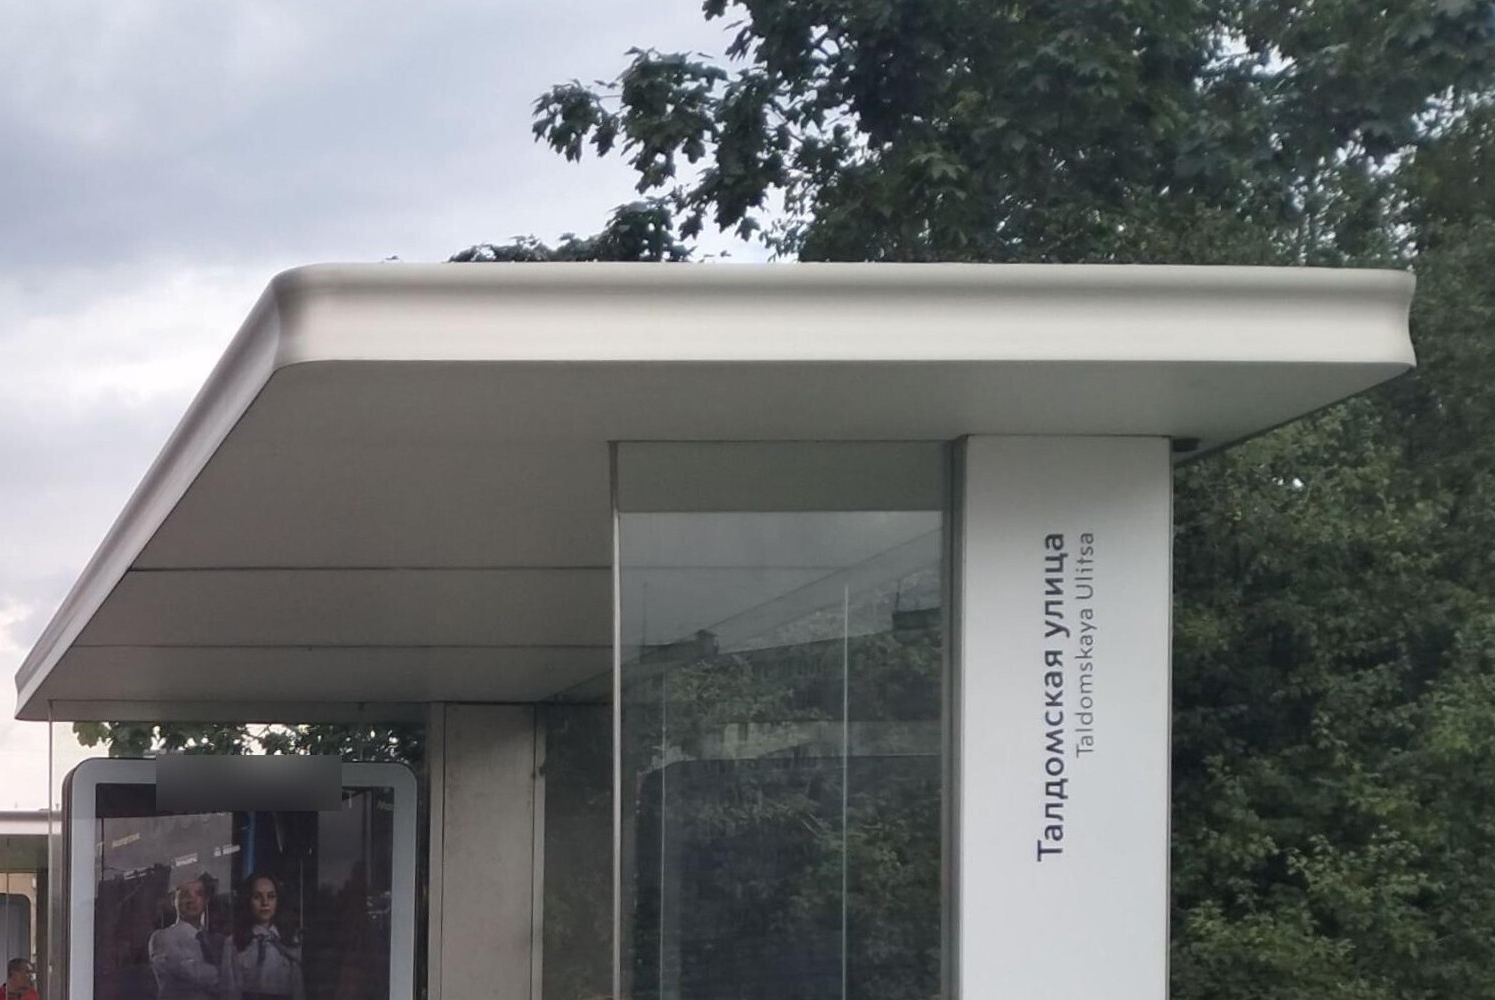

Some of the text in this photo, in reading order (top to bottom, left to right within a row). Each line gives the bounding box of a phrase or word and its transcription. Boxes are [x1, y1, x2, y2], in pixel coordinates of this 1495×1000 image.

[1036, 532, 1070, 863] Талдомская улица
[1074, 531, 1098, 758] Taldomskaya Ulitsa
